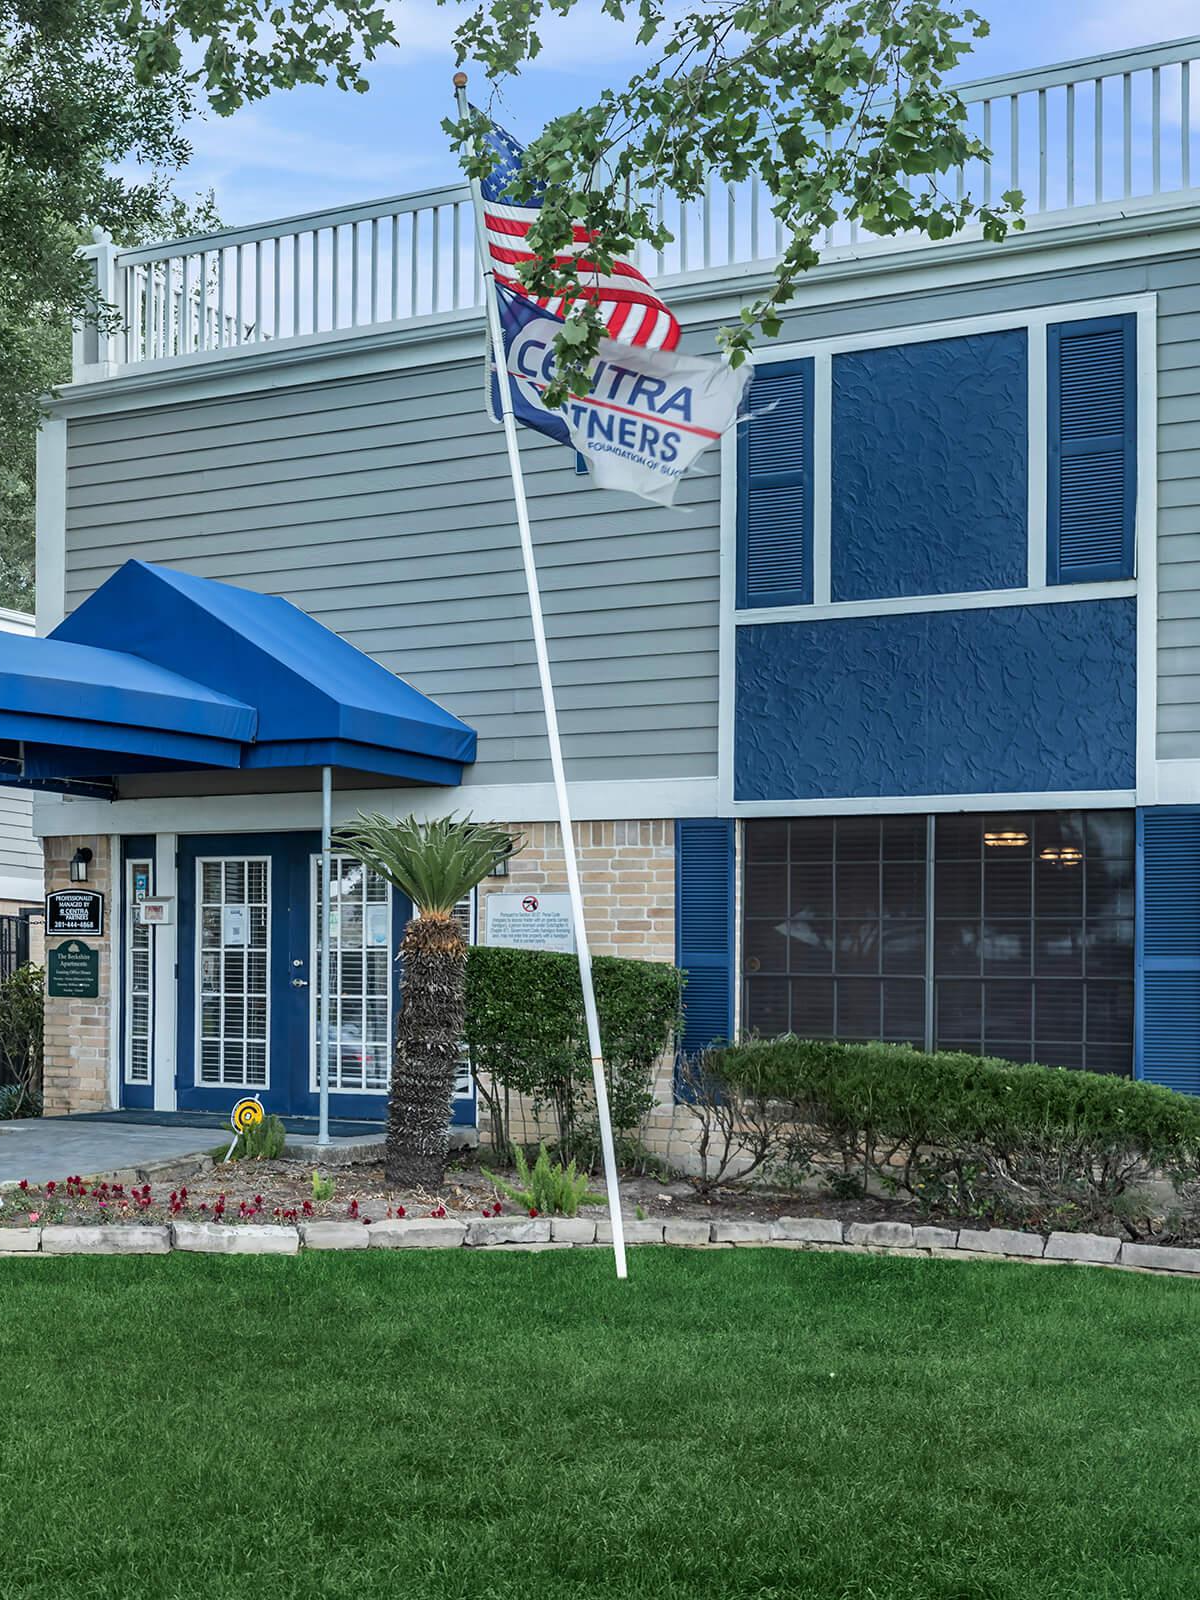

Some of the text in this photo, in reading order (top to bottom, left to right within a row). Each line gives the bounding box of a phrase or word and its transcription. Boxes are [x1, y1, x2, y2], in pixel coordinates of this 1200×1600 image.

[587, 441, 646, 466] FOUNDATION
[646, 459, 659, 471] OF
[59, 960, 88, 968] Apartments
